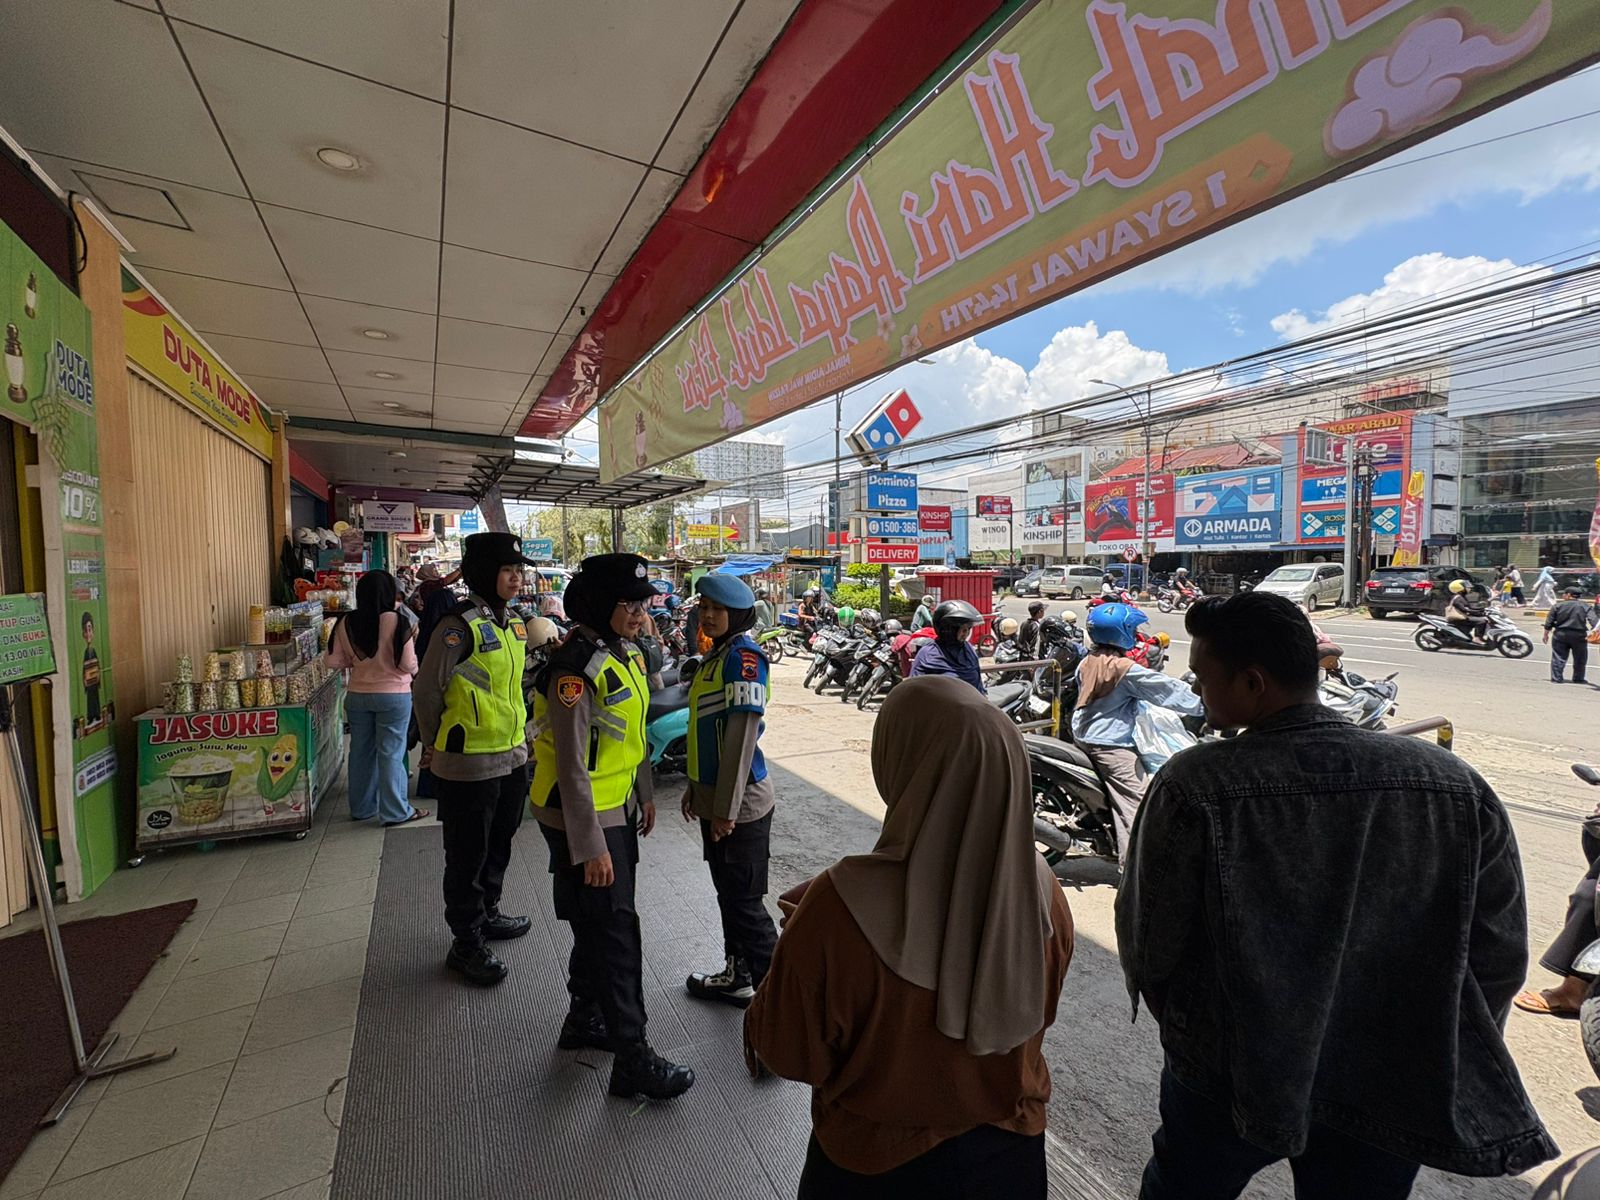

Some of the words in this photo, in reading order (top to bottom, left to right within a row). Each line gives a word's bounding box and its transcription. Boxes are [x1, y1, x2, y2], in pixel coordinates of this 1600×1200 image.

[55, 338, 92, 385] DUTA
[162, 321, 213, 394] DUTA
[215, 372, 252, 426] MODE
[58, 368, 93, 407] MODE
[1360, 416, 1403, 430] ABADI
[868, 474, 916, 487] Domino's
[63, 485, 97, 521] 10%
[878, 493, 908, 507] Pizza
[920, 511, 950, 519] KINSHIP
[880, 520, 917, 533] 1500-366
[1203, 517, 1272, 534] ARMADA
[1023, 530, 1062, 541] KINSHIP
[526, 541, 549, 549] Segar
[1119, 543, 1140, 551] OBAT
[869, 548, 916, 559] DELIVERY
[0, 602, 14, 611] AAF
[0, 618, 17, 629] TUP
[3, 635, 21, 645] DAN
[22, 630, 46, 642] BUKA
[4, 649, 28, 661] 13.00
[2, 666, 24, 677] KASIH
[725, 681, 767, 708] PRO
[149, 709, 280, 744] JASUKE
[155, 745, 197, 762] Jagung,
[226, 743, 248, 752] Keju
